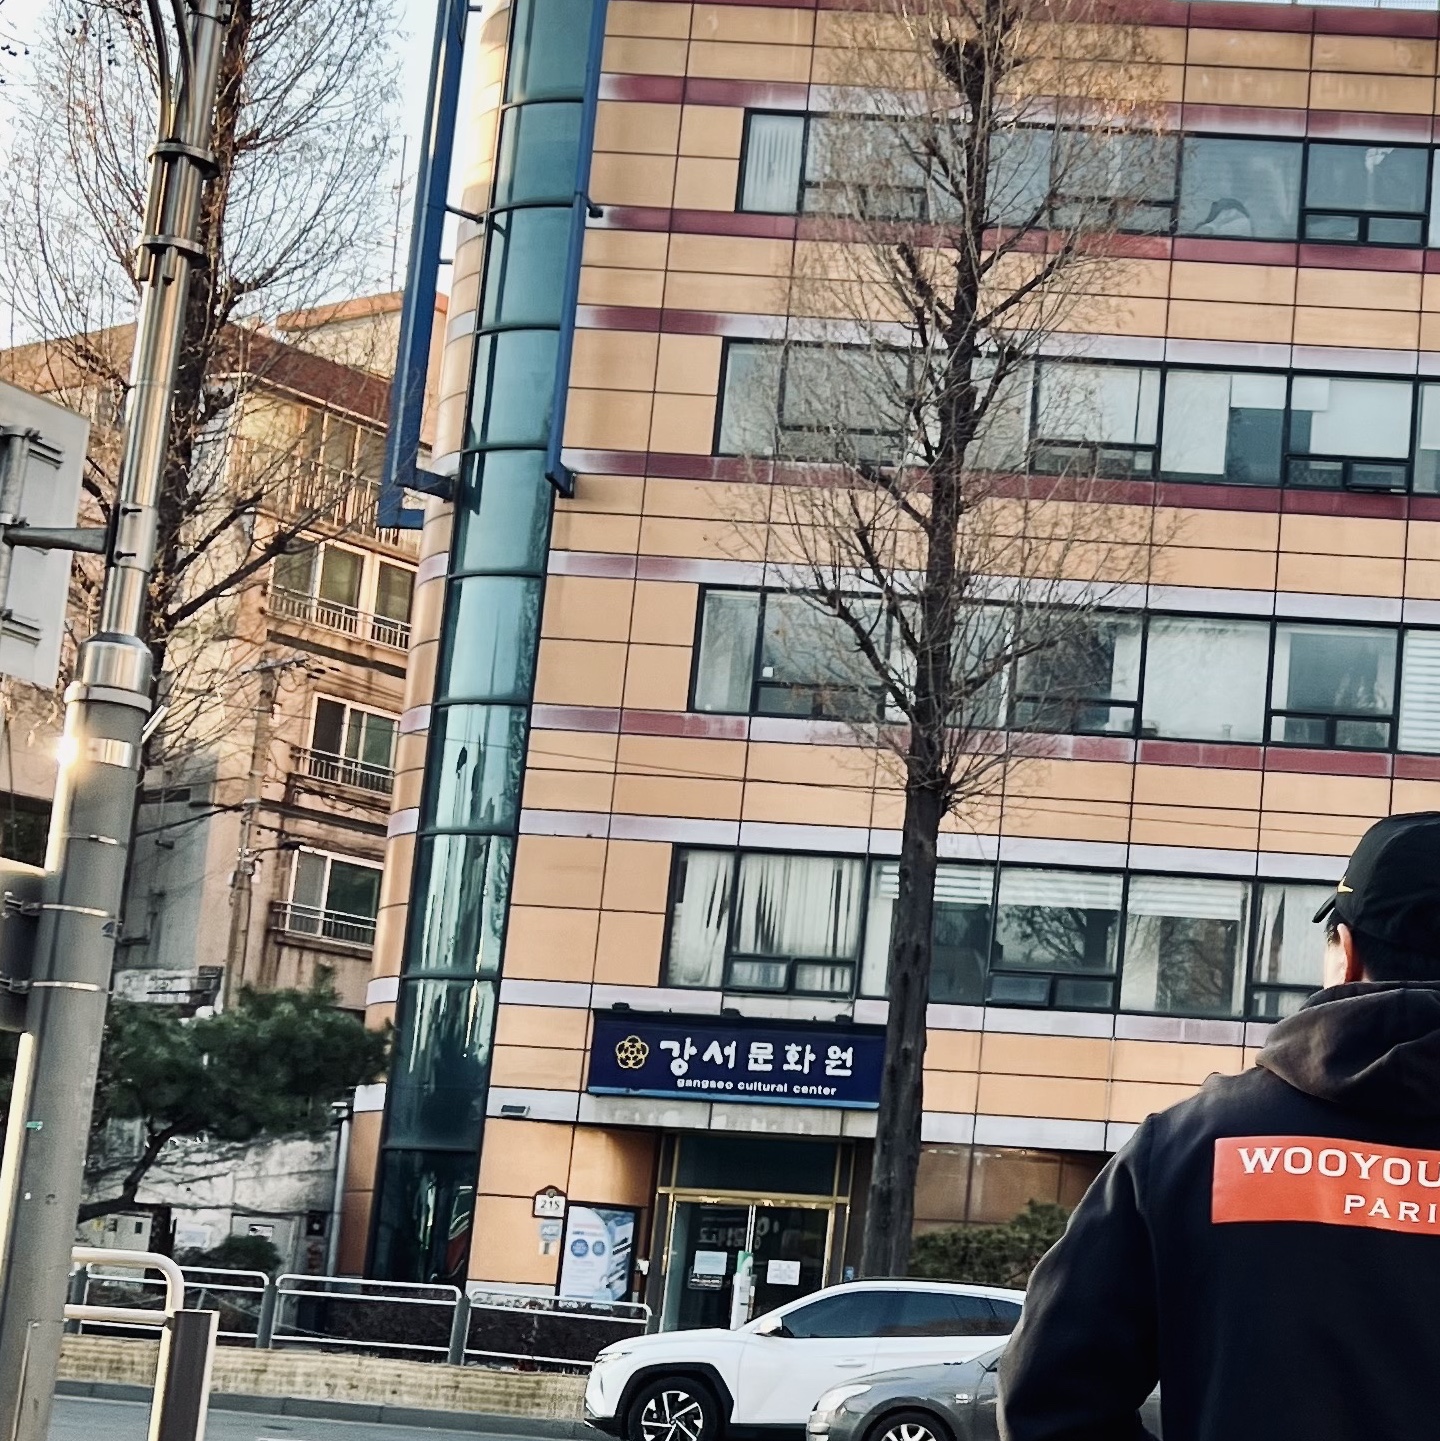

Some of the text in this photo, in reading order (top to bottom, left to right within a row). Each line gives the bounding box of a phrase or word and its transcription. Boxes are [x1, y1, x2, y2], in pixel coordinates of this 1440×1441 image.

[660, 1037, 853, 1077] 강서문화원
[677, 1078, 837, 1096] gangseo cultural center
[540, 1198, 560, 1210] 215
